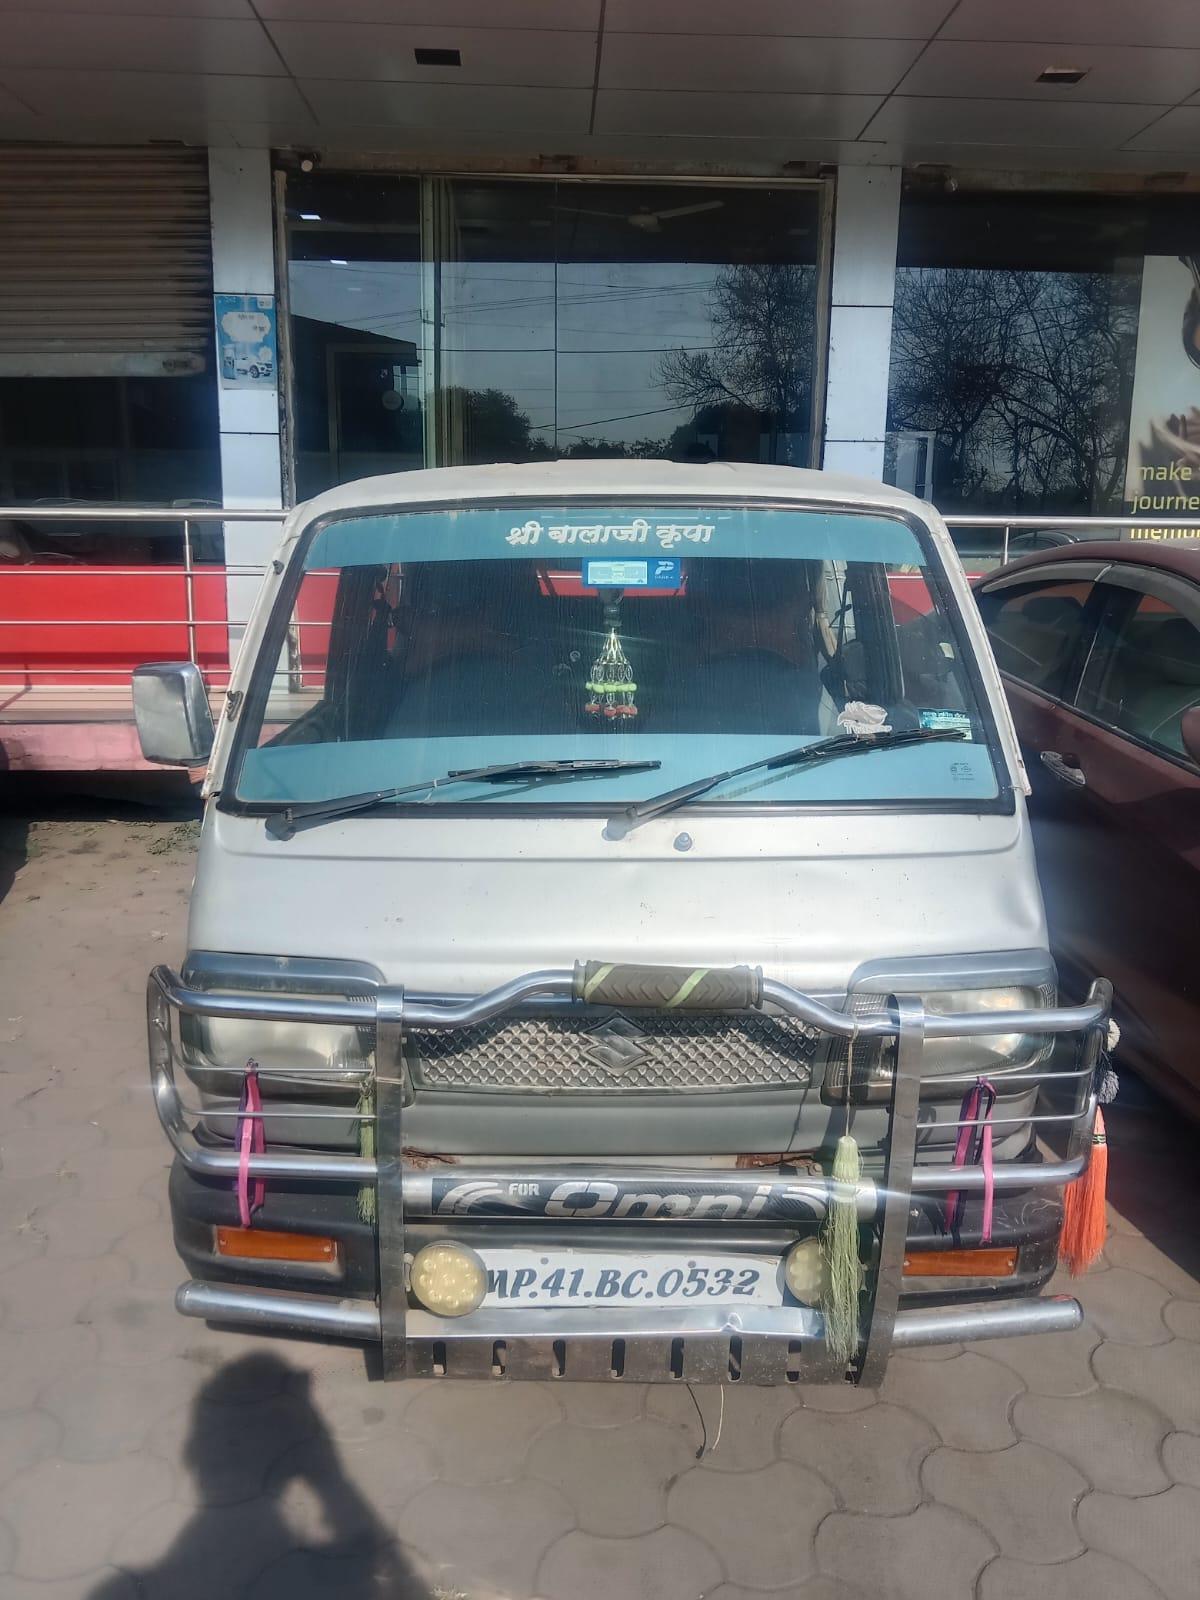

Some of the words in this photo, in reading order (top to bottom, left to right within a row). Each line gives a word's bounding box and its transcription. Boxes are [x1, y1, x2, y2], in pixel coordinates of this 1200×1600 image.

[1136, 461, 1192, 481] make
[506, 520, 544, 545] श्री
[548, 518, 651, 544] बालाजी
[656, 524, 715, 548] कृपा
[544, 1181, 772, 1219] Omni
